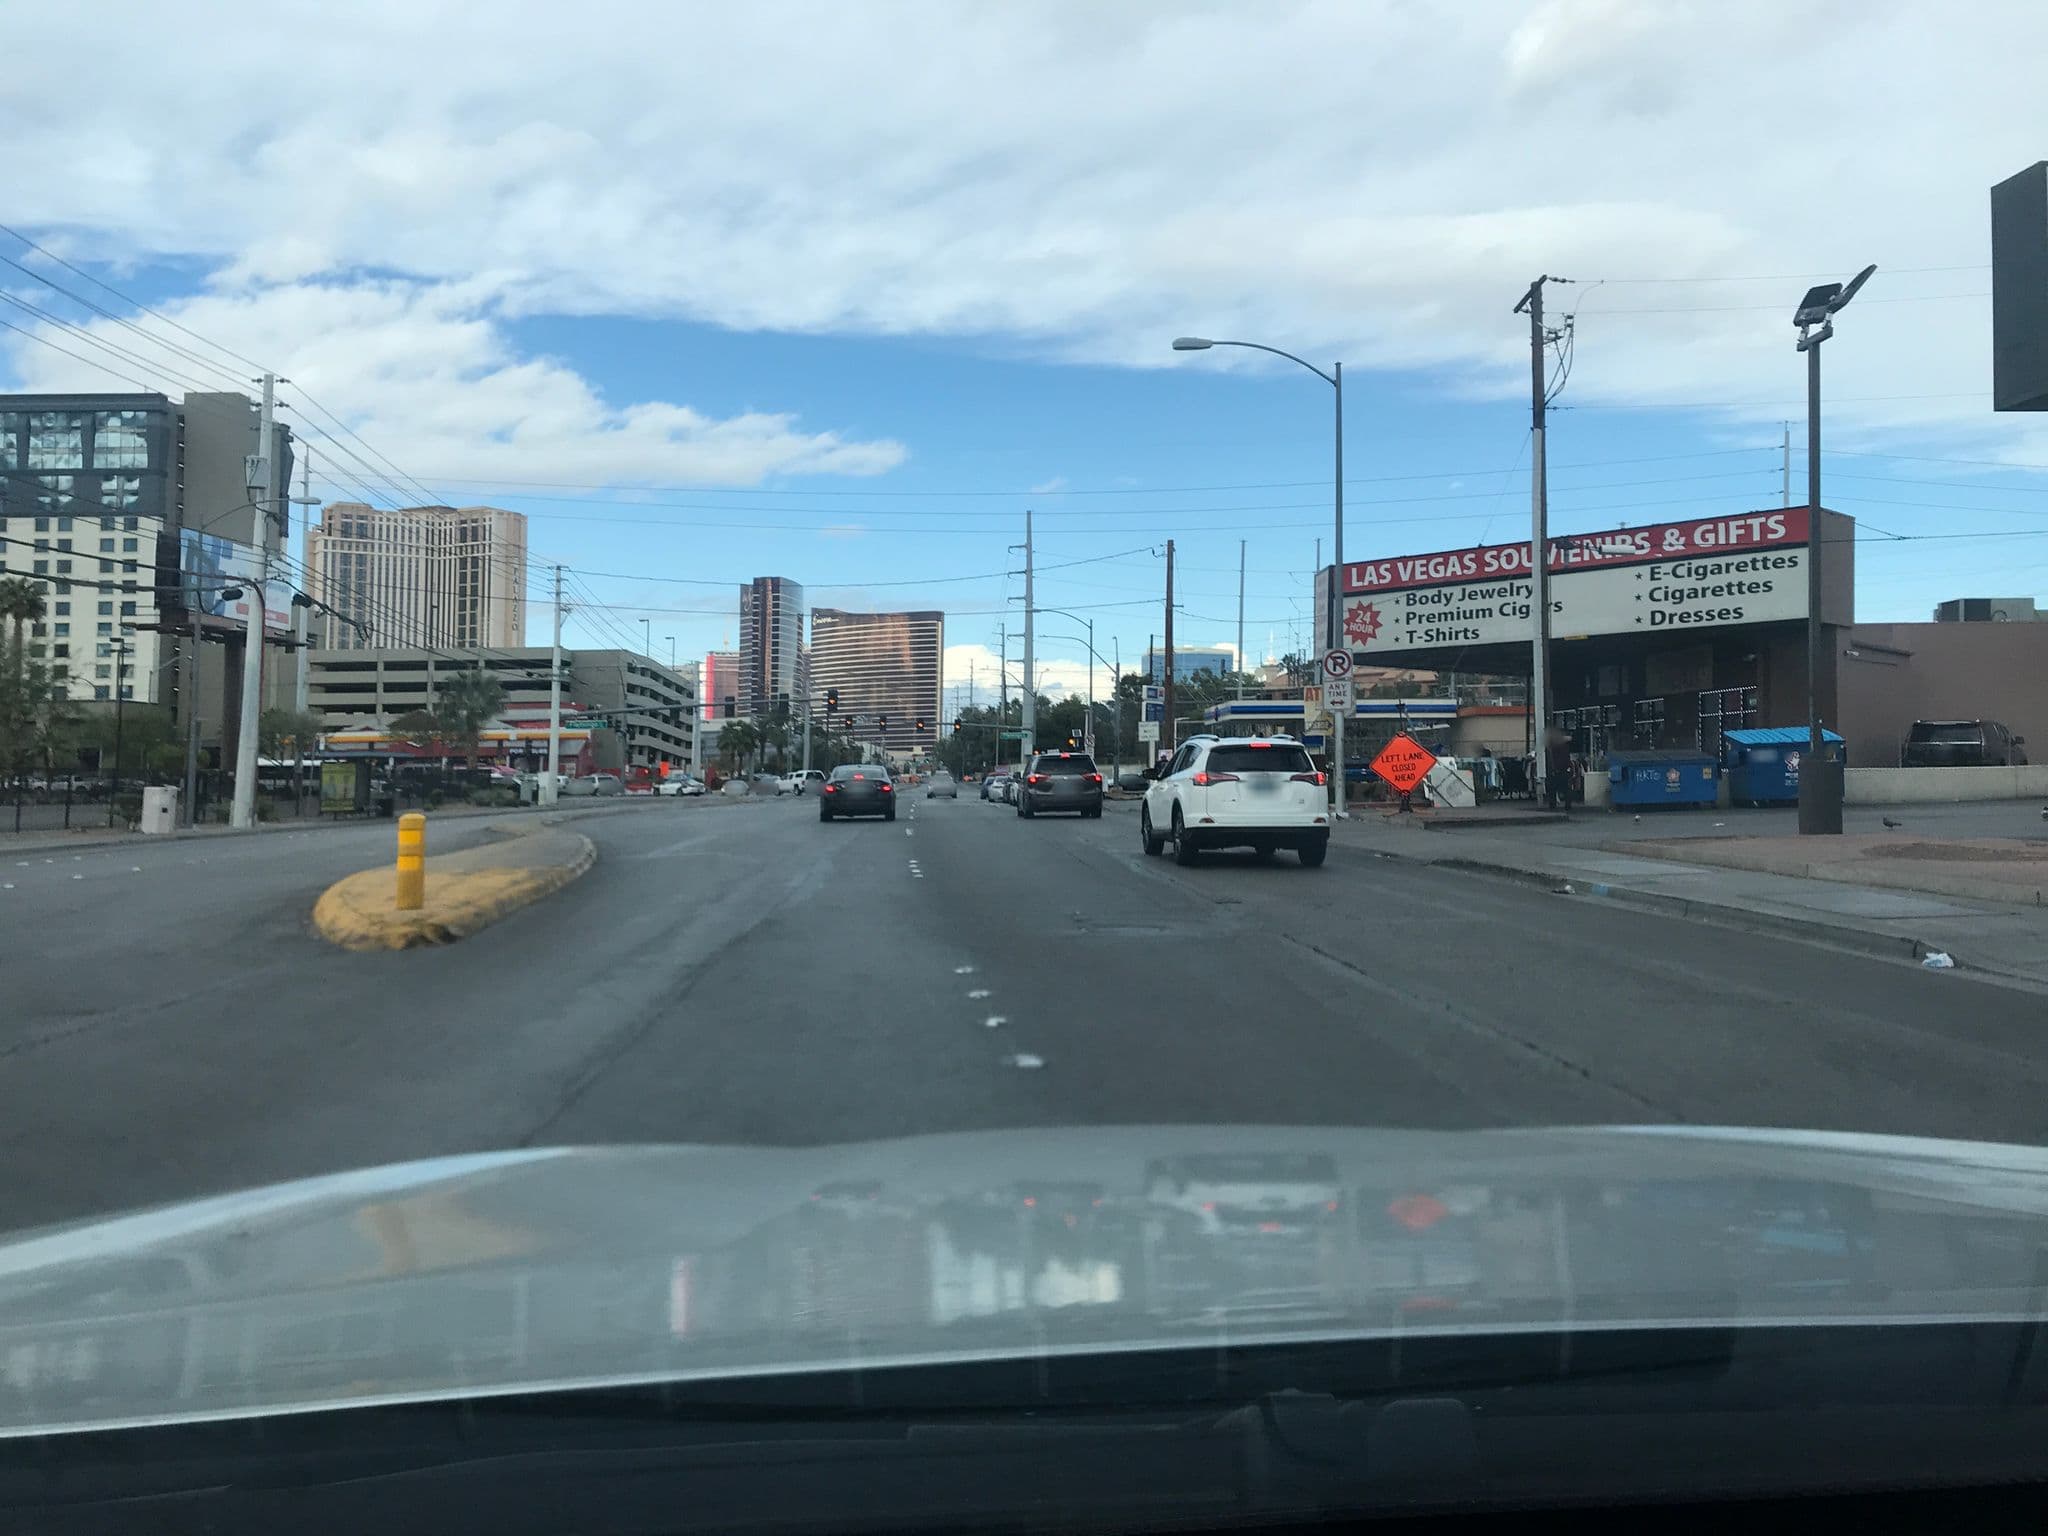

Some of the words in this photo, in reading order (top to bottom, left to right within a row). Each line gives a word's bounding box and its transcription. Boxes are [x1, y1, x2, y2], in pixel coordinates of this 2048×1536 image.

[1351, 563, 1392, 588] LAS
[1397, 551, 1477, 582] VEGAS
[1662, 528, 1686, 552] &
[1694, 514, 1786, 548] GIFTS
[1649, 554, 1799, 582] E-Cigarettes
[1405, 590, 1454, 607] Body
[1458, 582, 1533, 602] Jewelry
[1648, 578, 1774, 605] Cigarettes
[1355, 610, 1371, 625] 24
[1405, 605, 1493, 625] Premium
[1498, 600, 1563, 620] Cigs
[1649, 604, 1744, 626] Dresses
[1349, 622, 1374, 635] HOUR
[1406, 626, 1480, 644] T-Shirts
[1328, 683, 1347, 691] ANY
[1328, 690, 1348, 698] TIME
[1381, 753, 1400, 763] LEFT
[1403, 751, 1424, 762] LANE
[1391, 763, 1417, 772] CLOSED
[1394, 773, 1416, 782] AHEAD
